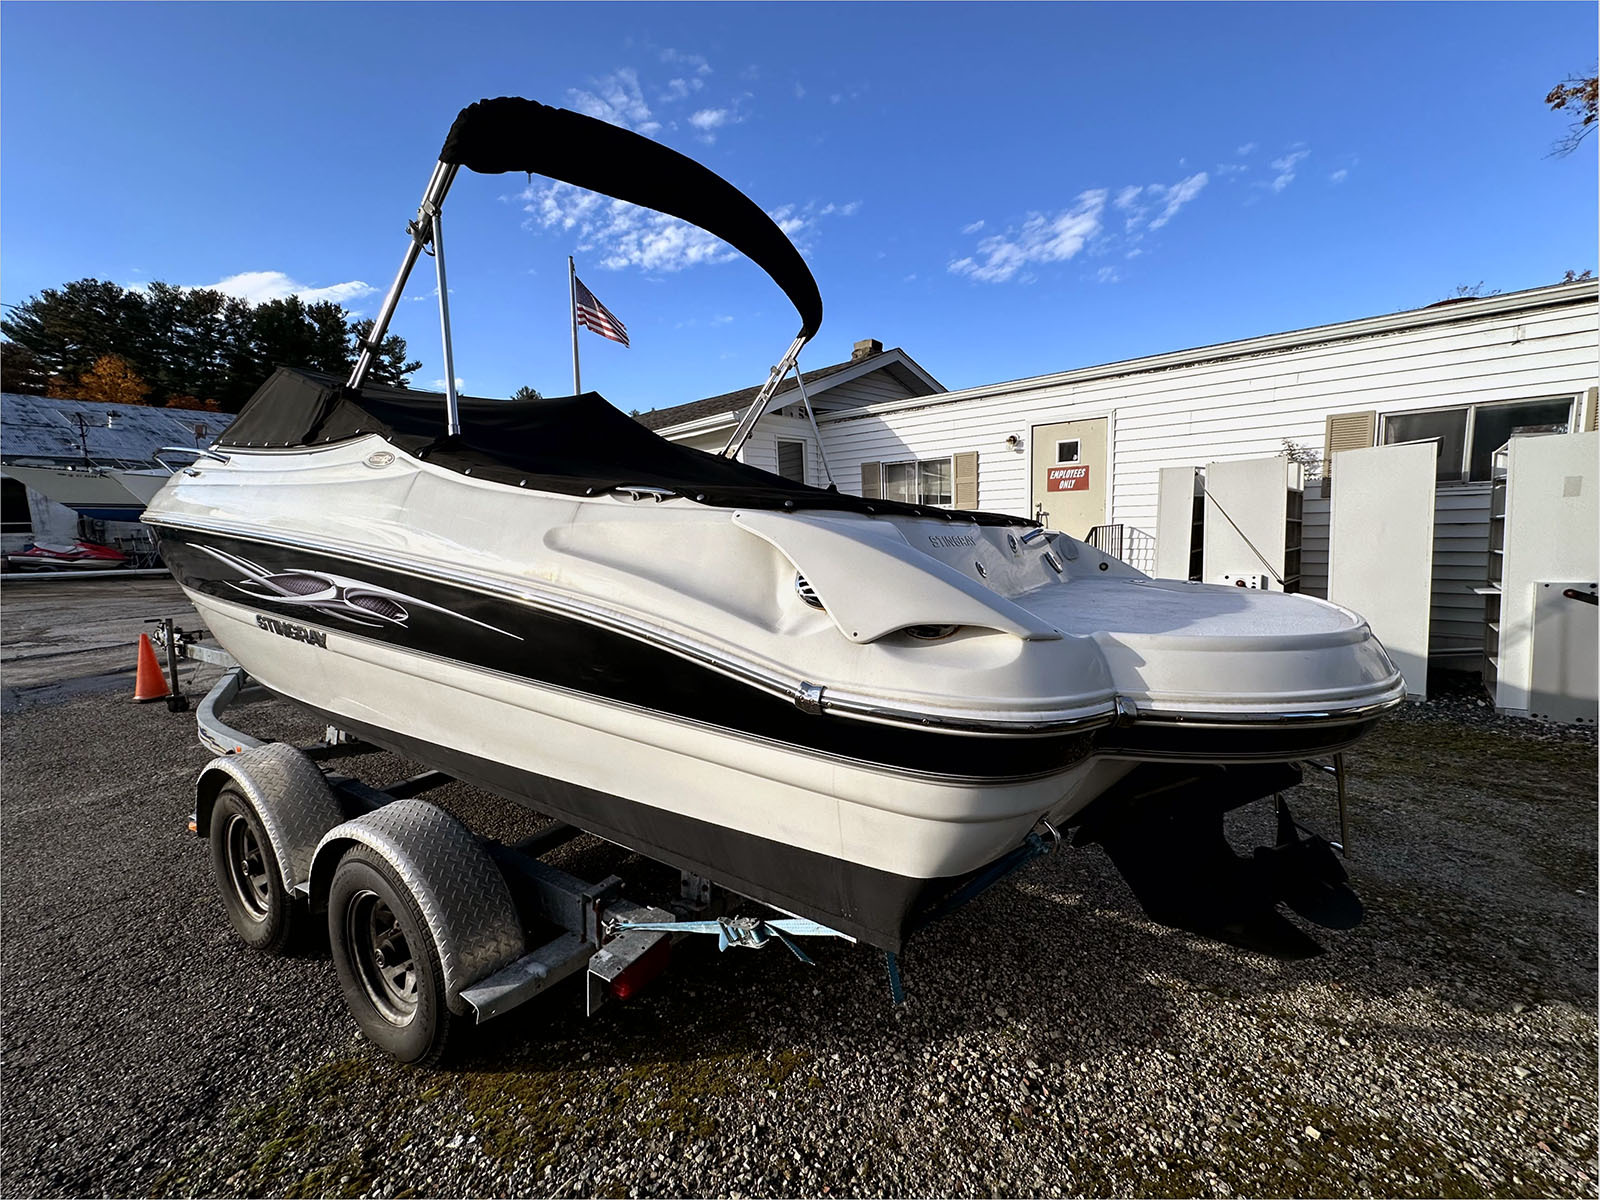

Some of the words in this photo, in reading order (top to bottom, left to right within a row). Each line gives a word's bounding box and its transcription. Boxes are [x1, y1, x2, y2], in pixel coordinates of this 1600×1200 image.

[1050, 468, 1086, 480] EMPLOYEES
[1059, 479, 1076, 489] ONLY
[928, 535, 976, 548] STINGRAY
[256, 614, 327, 649] STINGRAY
